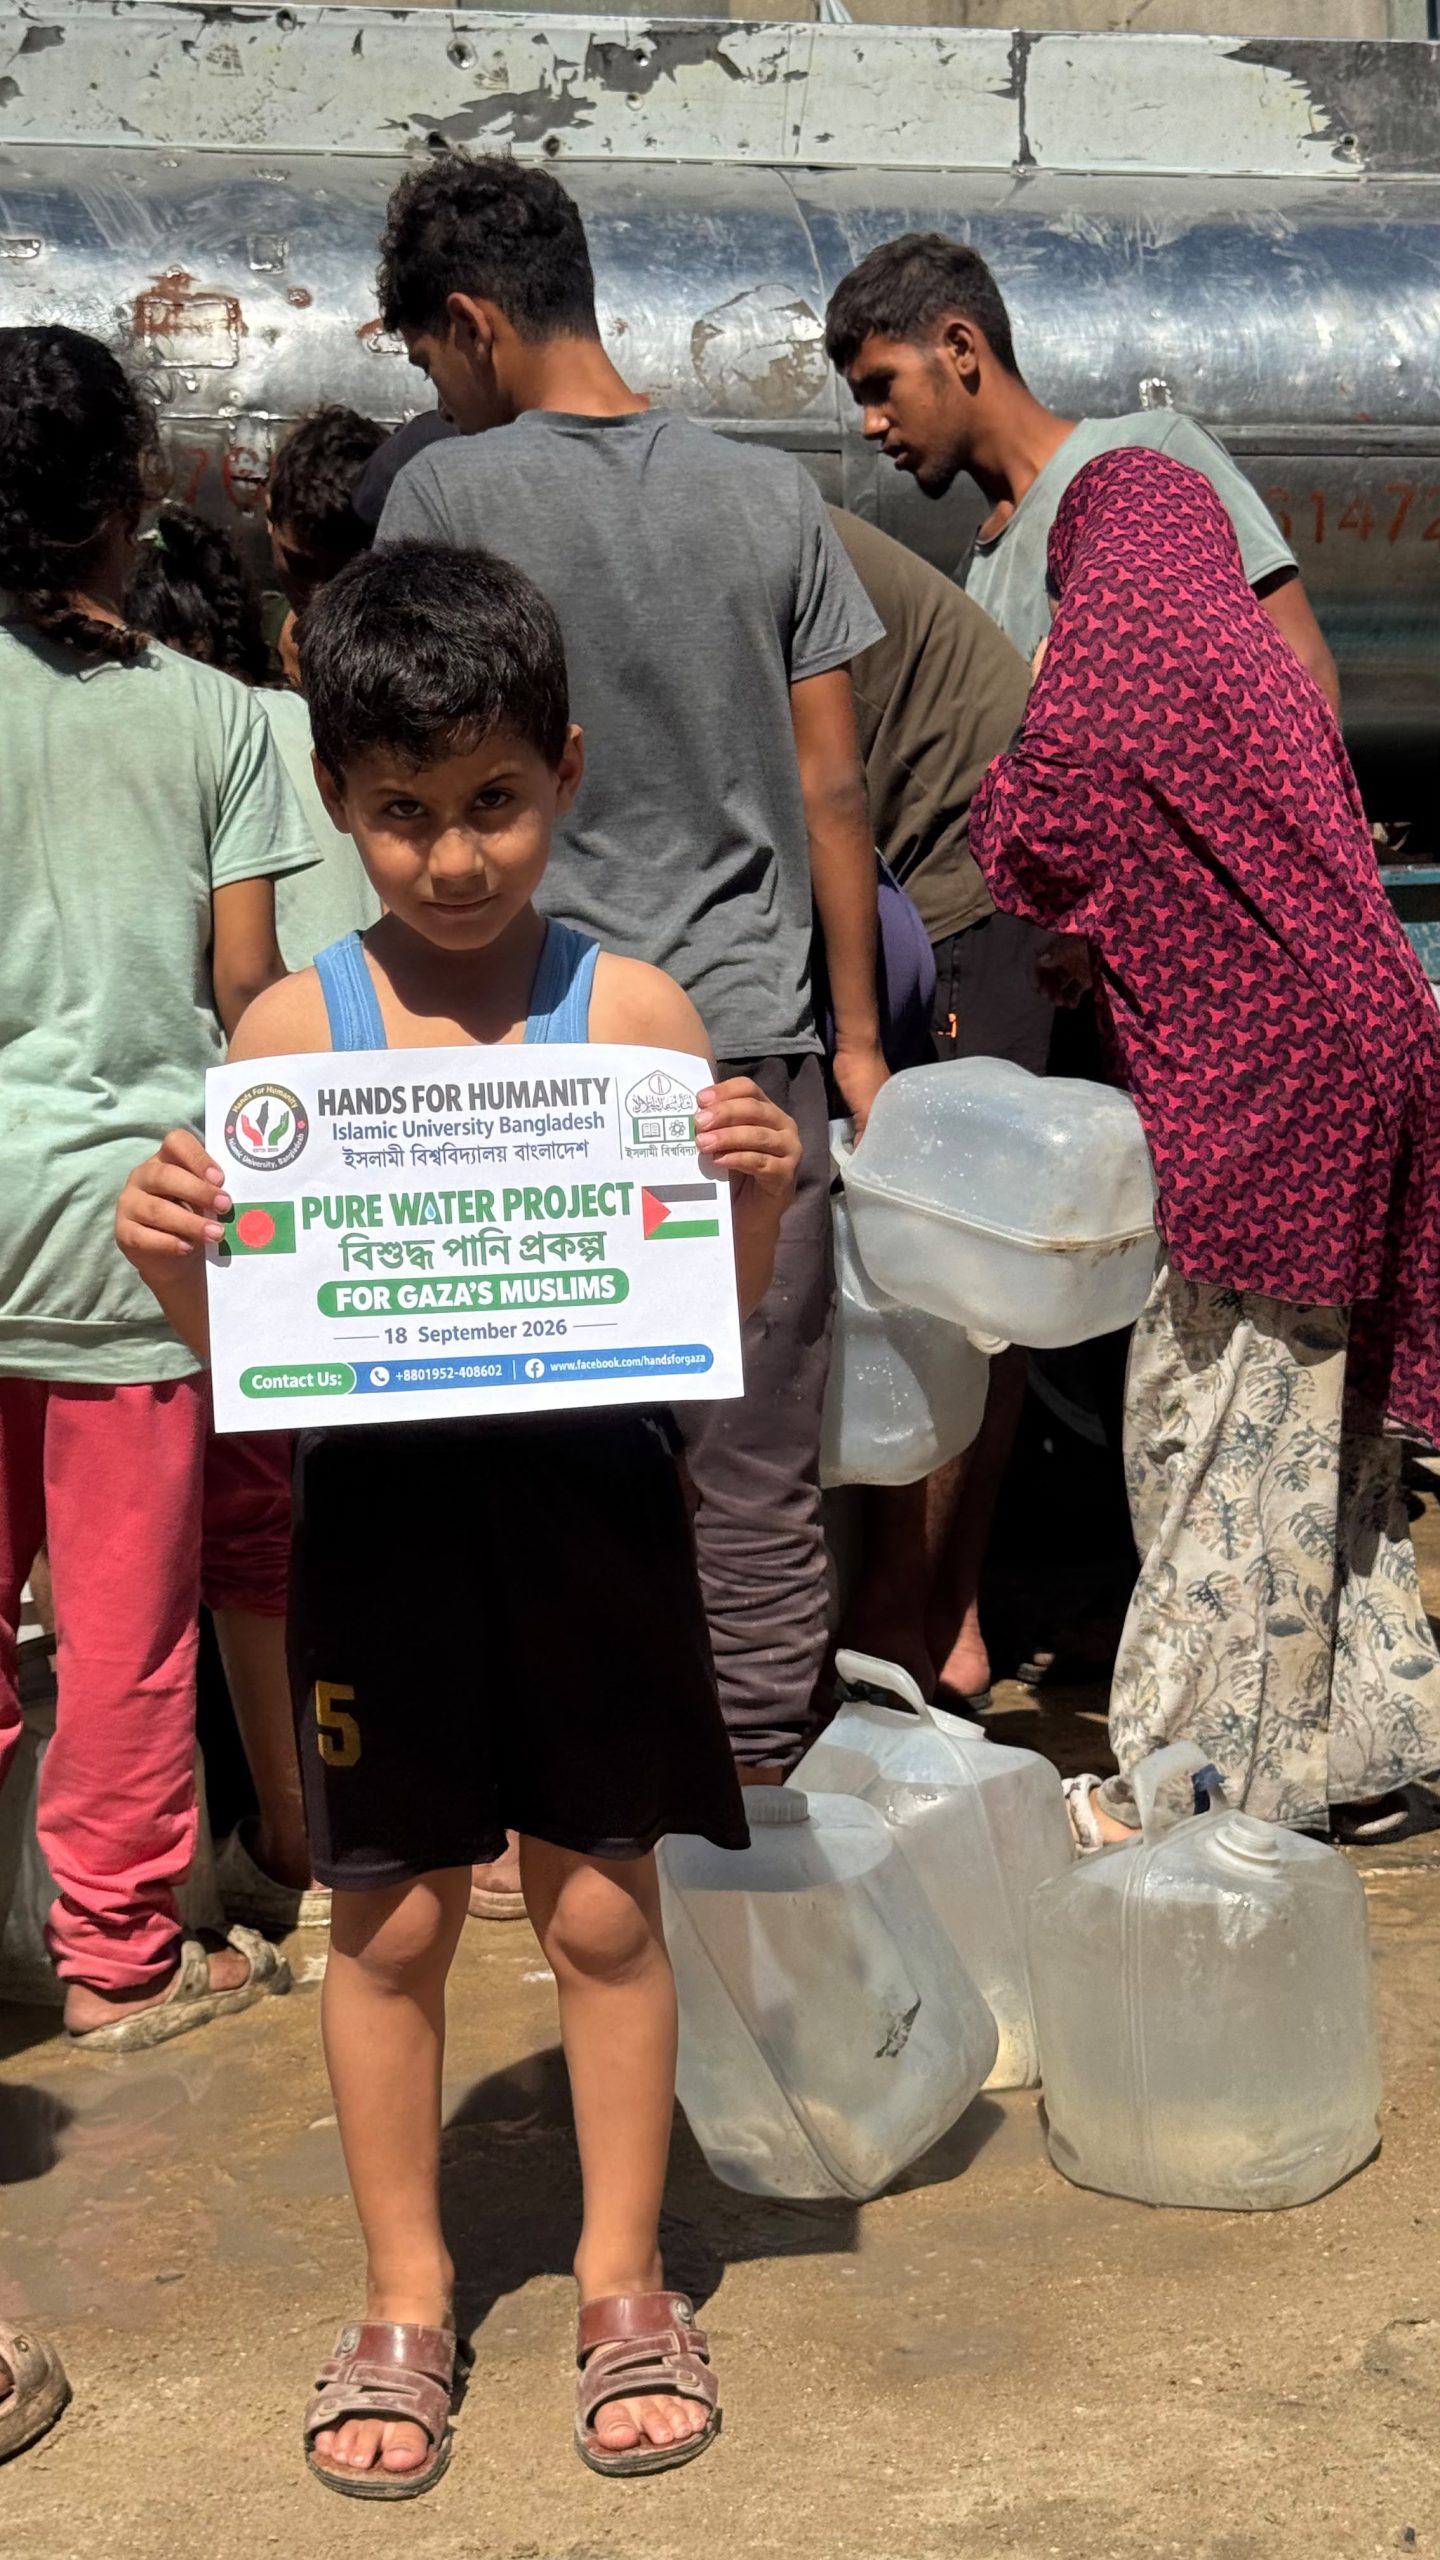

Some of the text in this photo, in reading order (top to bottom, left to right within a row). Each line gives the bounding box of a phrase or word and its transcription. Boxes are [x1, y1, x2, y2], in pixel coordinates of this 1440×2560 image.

[232, 1085, 299, 1113] Hands For Humanity
[318, 1084, 407, 1117] HANDS
[412, 1083, 463, 1114] FOR
[468, 1077, 611, 1112] HUMANITY
[332, 1111, 605, 1141] Islamic University Bangladesh
[228, 1137, 243, 1160] Islamic
[277, 1133, 305, 1165] Bangladesh
[342, 1139, 589, 1170] ইসলামী বিশ্ববিদ্যালয় বাংলাদেশ
[301, 1181, 635, 1230] PURE WATER PROJECT
[337, 1226, 608, 1272] বিশুদ্ধ পানি প্রকল্প
[335, 1274, 616, 1312] FOR GAZA'S MUSLIMS
[384, 1319, 568, 1346] 18 September 2026
[251, 1364, 503, 1390] Contact Us: +8801952-408602
[550, 1351, 706, 1373] www.facebook.com/handsforgaza
[315, 1680, 361, 1767] 5
